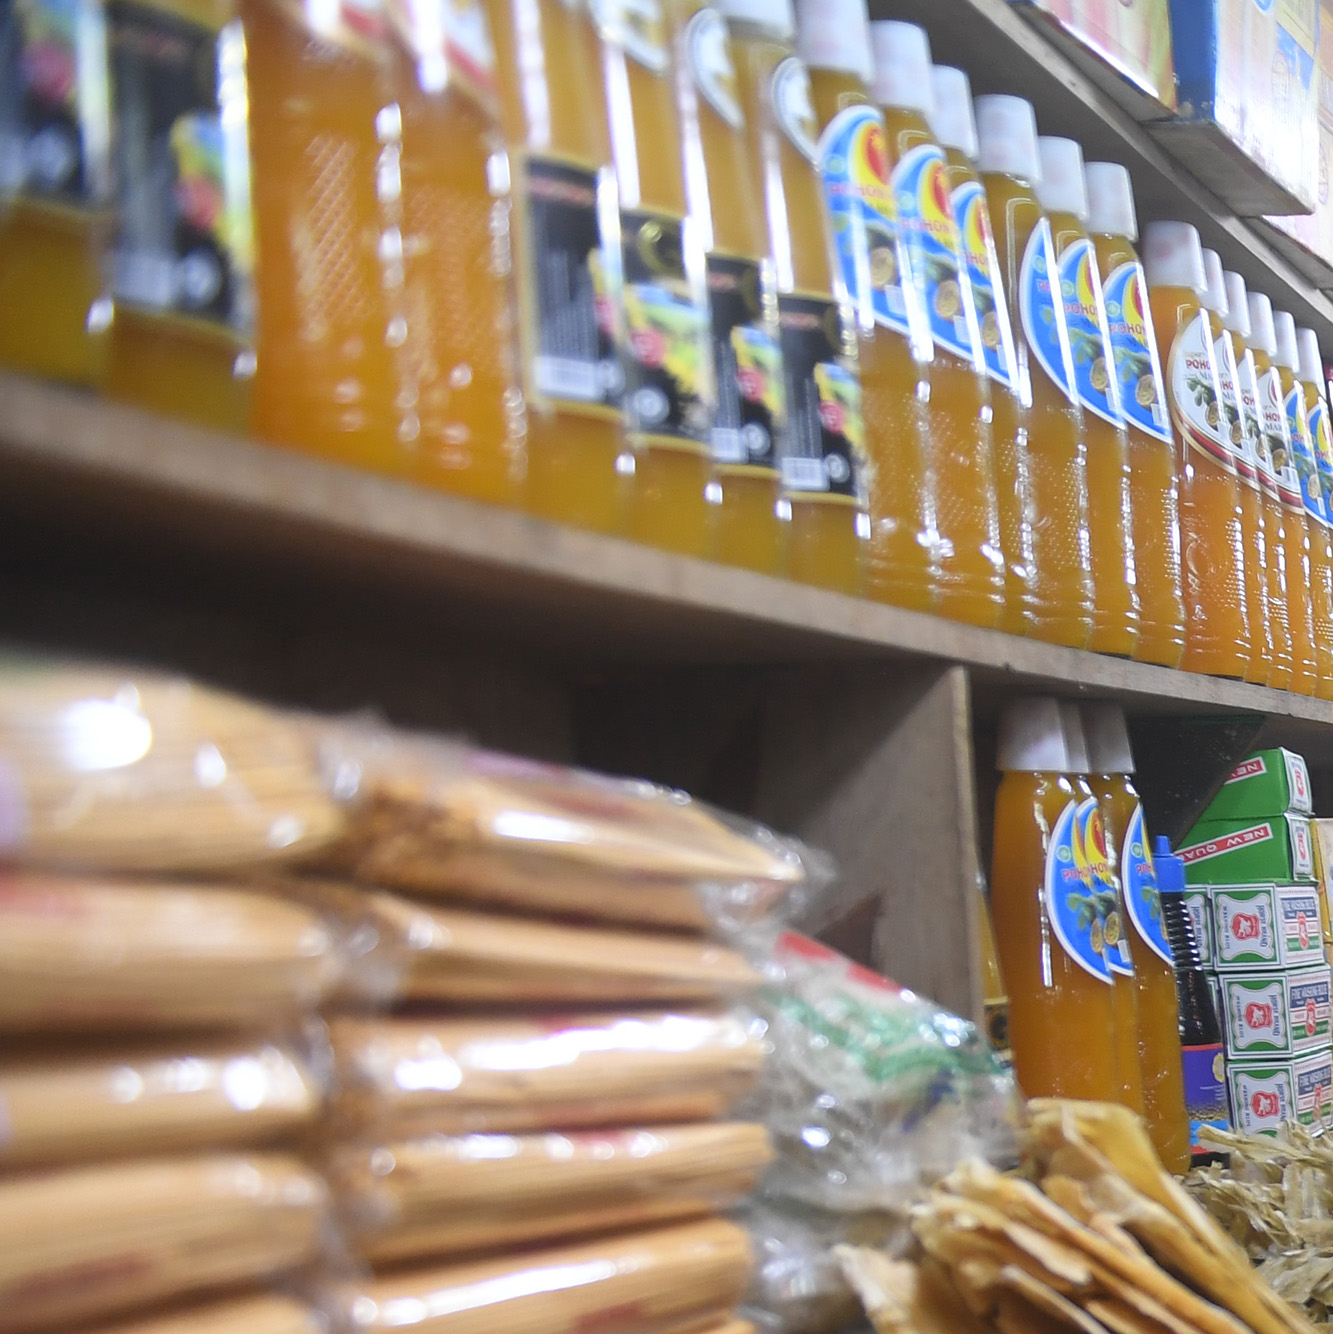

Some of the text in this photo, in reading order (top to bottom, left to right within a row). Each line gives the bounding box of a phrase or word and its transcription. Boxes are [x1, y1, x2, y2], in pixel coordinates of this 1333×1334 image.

[1064, 303, 1097, 315] POHO
[1109, 323, 1146, 335] POHO
[1186, 360, 1210, 370] POHO
[1227, 829, 1265, 847] NEW
[1256, 905, 1269, 948] HORSE BRAND
[1268, 994, 1281, 1037] HORSE BRAND
[1275, 1083, 1286, 1103] HORSE
